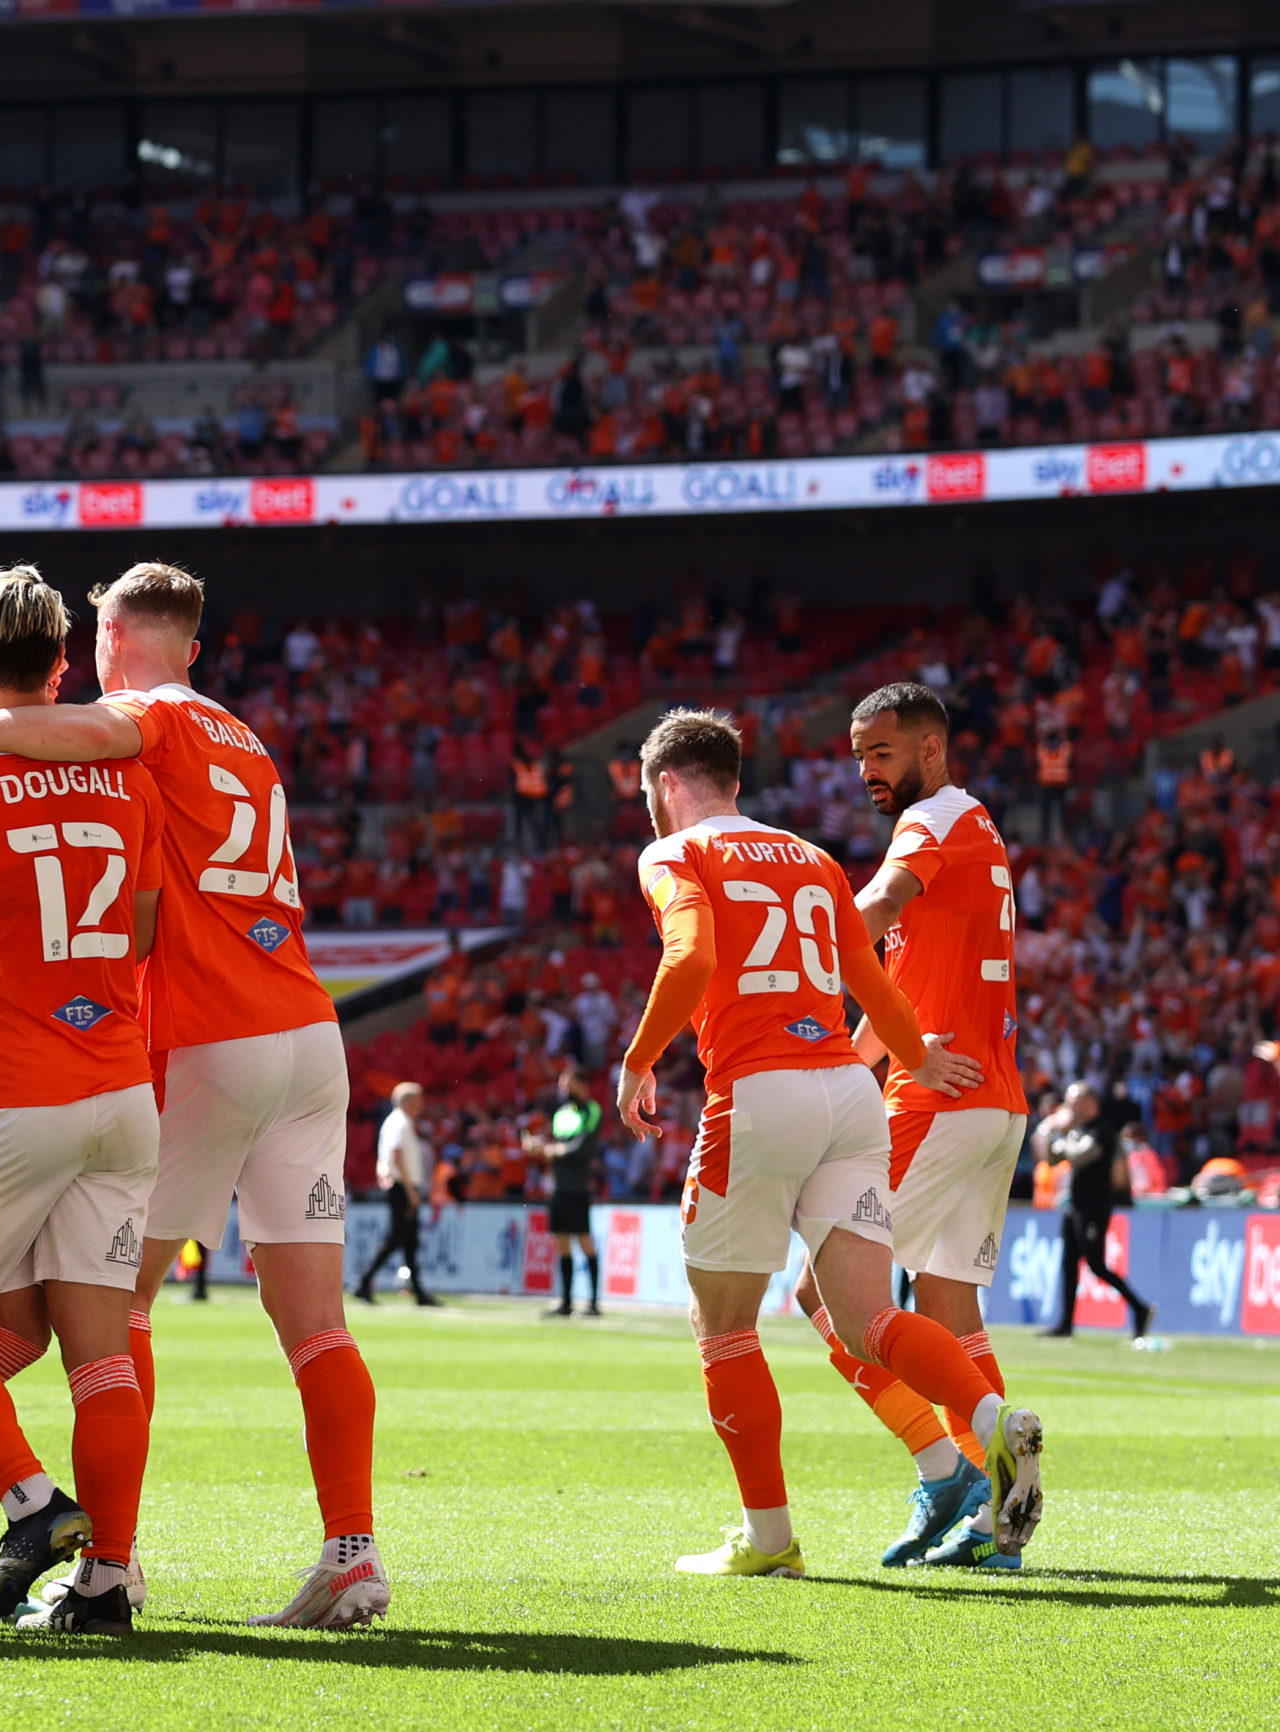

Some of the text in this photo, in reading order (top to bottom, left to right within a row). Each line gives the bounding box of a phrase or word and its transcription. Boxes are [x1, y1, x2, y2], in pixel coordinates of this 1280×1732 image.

[22, 488, 70, 523] sky
[83, 488, 139, 522] bet
[256, 483, 312, 518] bet
[401, 477, 515, 513] GOAL!
[683, 467, 797, 507] GOAL!
[725, 841, 823, 867] TURTON
[6, 822, 130, 962] 12
[253, 926, 278, 942] FTS
[722, 879, 841, 996] 20
[65, 1005, 94, 1021] FTS
[797, 1023, 820, 1037] FTS
[1010, 1218, 1065, 1320] sky
[1190, 1218, 1246, 1327] sky
[328, 1562, 376, 1597] PUMA
